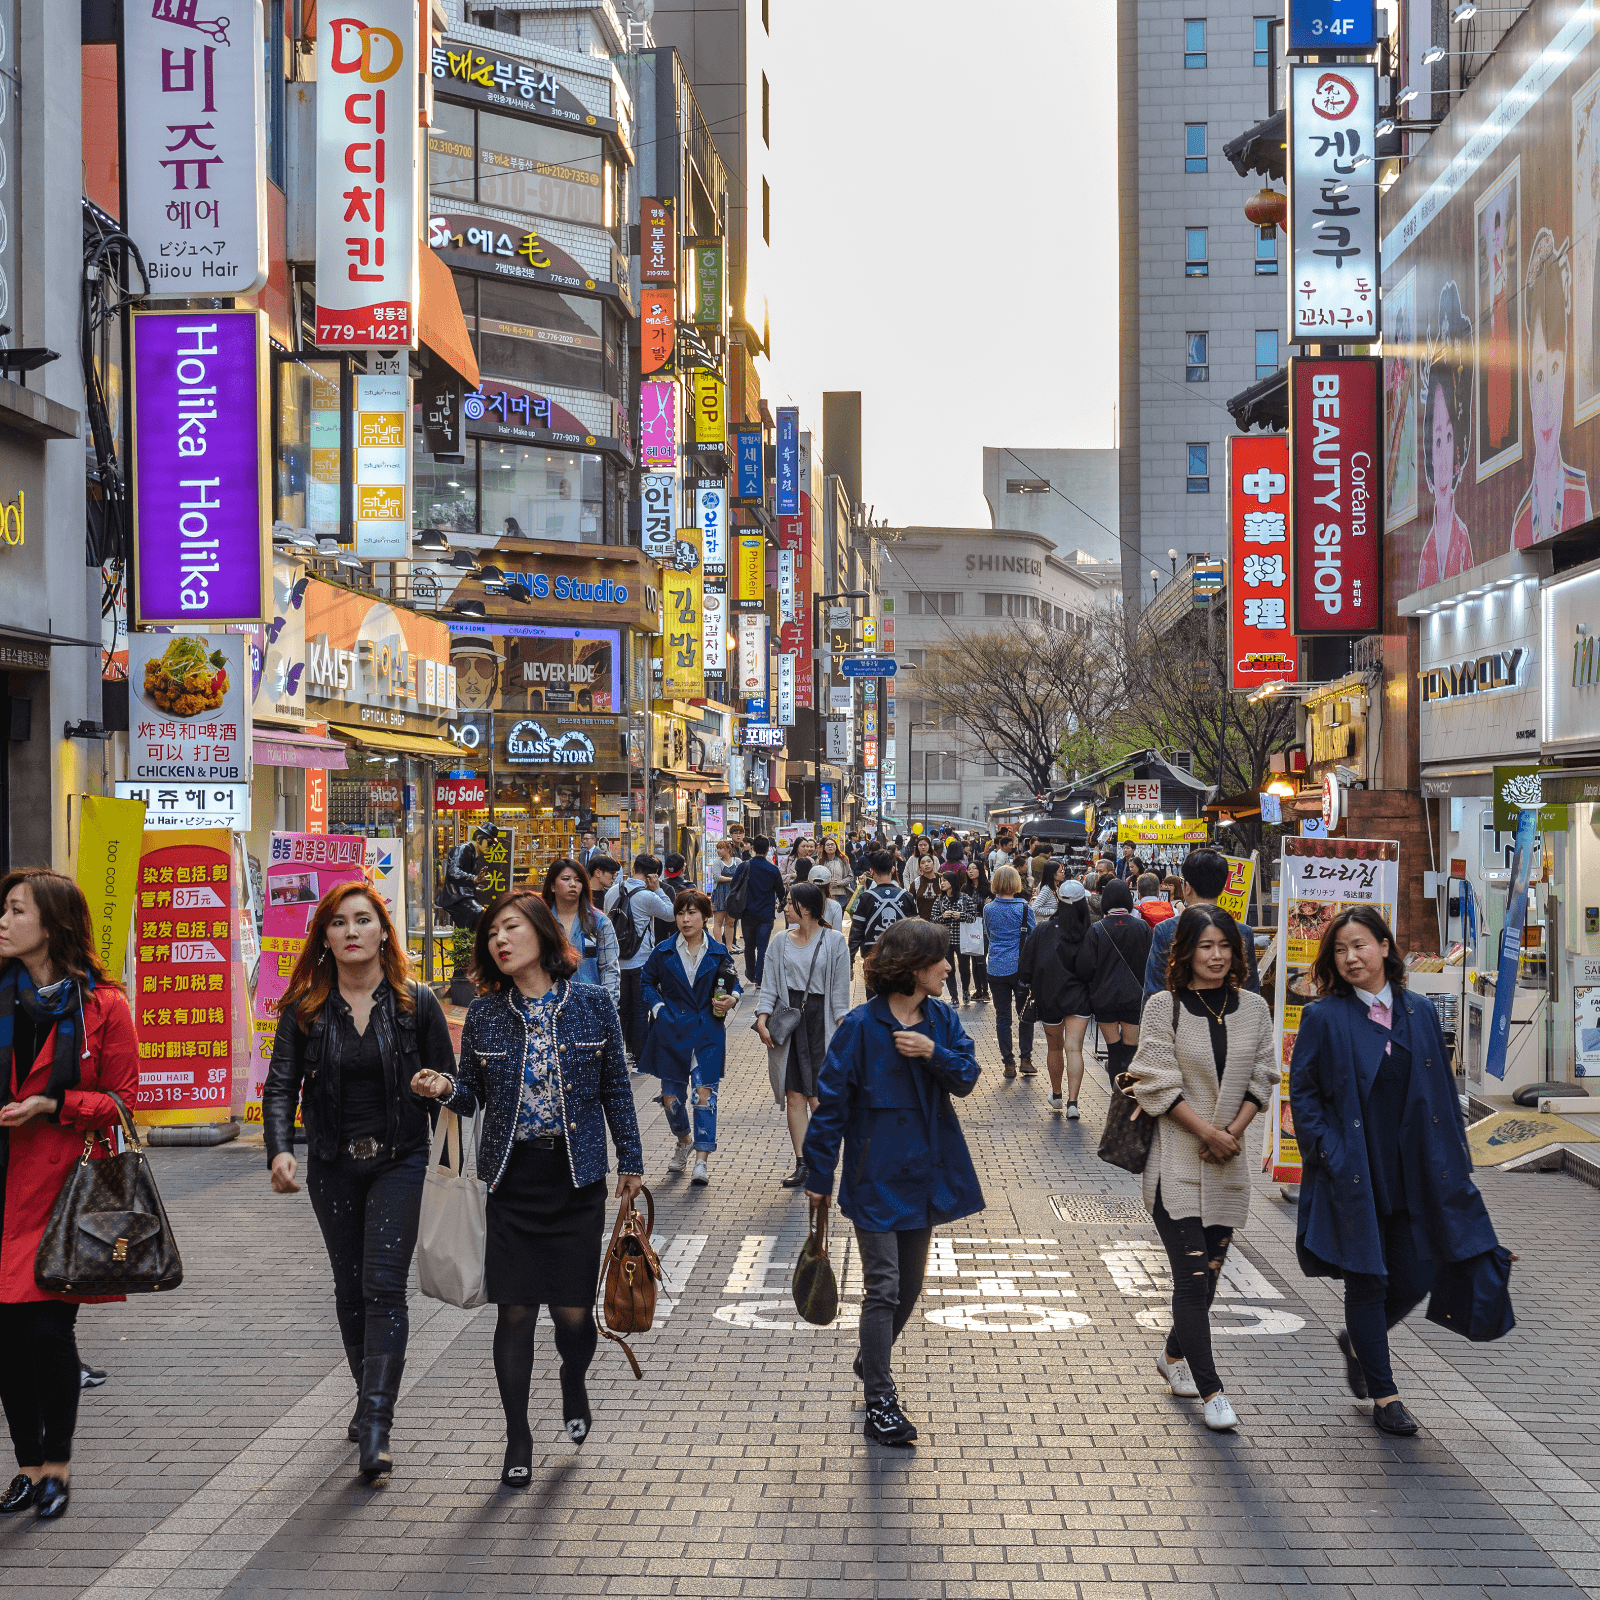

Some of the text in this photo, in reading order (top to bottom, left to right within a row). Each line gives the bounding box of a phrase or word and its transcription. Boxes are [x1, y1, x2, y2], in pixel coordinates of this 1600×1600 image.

[551, 107, 580, 121] 310-9700
[536, 162, 590, 184] 010-2120-7353
[342, 88, 387, 284] 디디치킨
[481, 165, 597, 227] 310-9700
[166, 199, 221, 231] 헤어
[160, 240, 227, 258] ビジュヘア
[650, 227, 666, 268] 부동산
[148, 259, 240, 281] Bijou Hair
[550, 273, 580, 287] 776-2020
[373, 306, 409, 322] 명동점
[1298, 308, 1374, 329] 꼬치구이
[320, 323, 409, 342] 779-1421
[651, 328, 667, 361] 가발
[664, 363, 673, 371] 4F
[701, 382, 719, 424] TOP
[363, 424, 401, 445] Style mall
[552, 432, 580, 444] 777-9079
[176, 323, 221, 612] Holika Holika
[743, 447, 759, 494] 세탁소
[1311, 374, 1343, 615] BEAUTY SHOP
[362, 497, 401, 518] Style mall
[644, 487, 672, 543] 안경
[363, 537, 383, 545] Style
[555, 575, 629, 604] Studio
[668, 587, 699, 668] 김밥
[310, 633, 359, 690] KAIST
[523, 661, 596, 683] NEVER HIDE
[1416, 648, 1526, 703] TONYMOLY
[361, 708, 405, 726] OPTICAL SHOP
[137, 721, 237, 742] 炸鸡和啤酒
[146, 743, 230, 763] 可以 打包
[508, 740, 552, 754] GLASS
[552, 750, 596, 764] STORY
[137, 765, 239, 779] CHICKEN & PUB
[436, 785, 485, 805] Big Sale
[1126, 784, 1160, 800] 부동산
[157, 816, 178, 826] Hair
[107, 840, 121, 863] too
[104, 866, 117, 899] cool
[1301, 862, 1378, 889] 오다리집
[141, 891, 172, 909] 营养
[103, 901, 117, 922] for
[139, 945, 171, 963] 营养
[142, 974, 225, 993] 刷卡加税费
[141, 1007, 225, 1026] 长发有加钱
[138, 1040, 229, 1059] 随时翻译可能
[166, 1073, 190, 1082] HAIR
[207, 1068, 228, 1083] 3F
